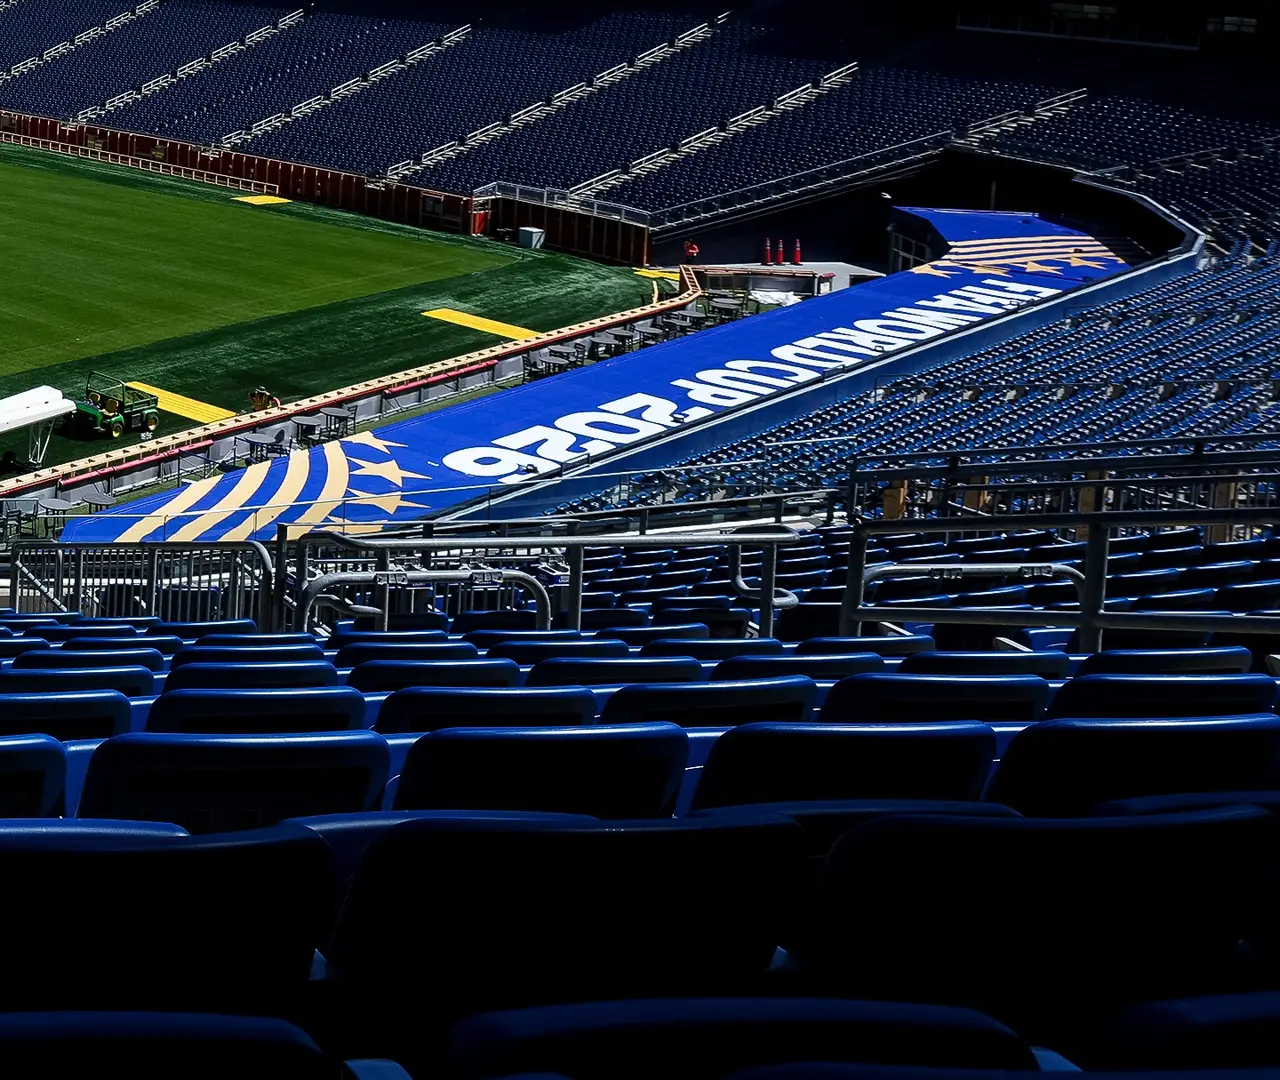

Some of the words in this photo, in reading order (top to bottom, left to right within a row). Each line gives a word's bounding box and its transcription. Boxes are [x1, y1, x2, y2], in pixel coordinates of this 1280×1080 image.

[914, 278, 1063, 315] FIFA
[770, 307, 984, 370] WORLD
[669, 359, 822, 407] CUP
[442, 392, 715, 484] 2026
